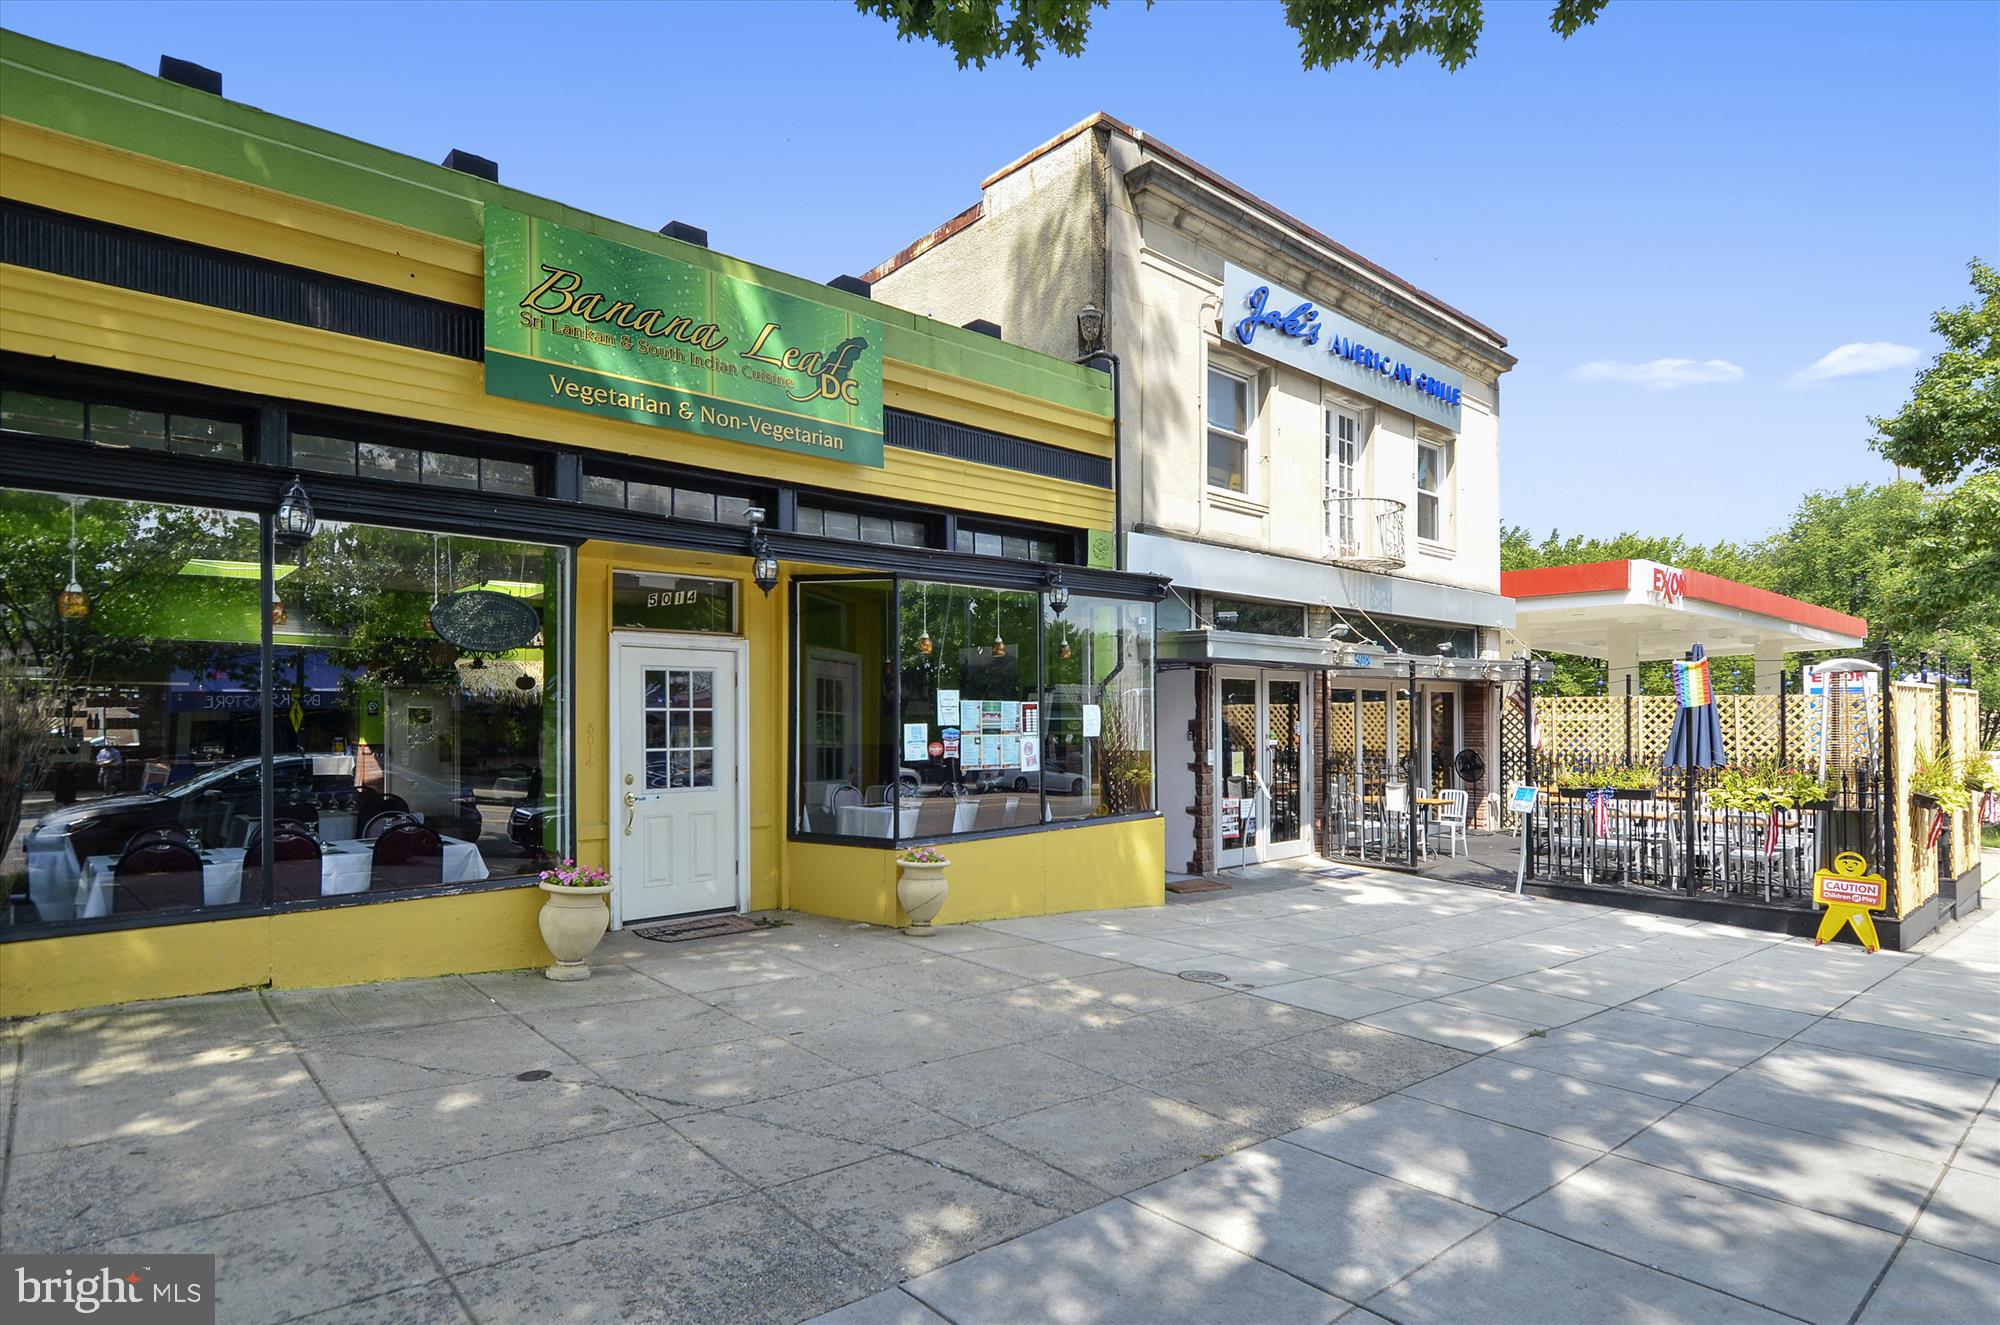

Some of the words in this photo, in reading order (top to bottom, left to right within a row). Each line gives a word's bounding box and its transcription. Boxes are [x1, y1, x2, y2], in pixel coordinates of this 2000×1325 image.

[519, 264, 728, 351] Banana
[740, 322, 863, 401] Leaf
[1235, 286, 1322, 345] Jake's
[520, 310, 546, 329] Sri
[550, 317, 616, 347] Lankan
[620, 335, 634, 351] &
[638, 338, 686, 365] South
[690, 351, 738, 377] Indian
[742, 364, 795, 390] Cuisine
[1329, 333, 1412, 386] AMERICAN
[1416, 373, 1461, 407] GRILLE
[548, 373, 672, 417] Vegetarian
[678, 400, 694, 420] &
[701, 405, 844, 450] Non-Vegetarian
[820, 373, 860, 406] DC
[648, 590, 697, 607] 5014
[1653, 567, 1687, 605] EXXON
[1823, 891, 1851, 900] Children
[1862, 896, 1877, 904] Play
[1826, 881, 1876, 894] CAUTION
